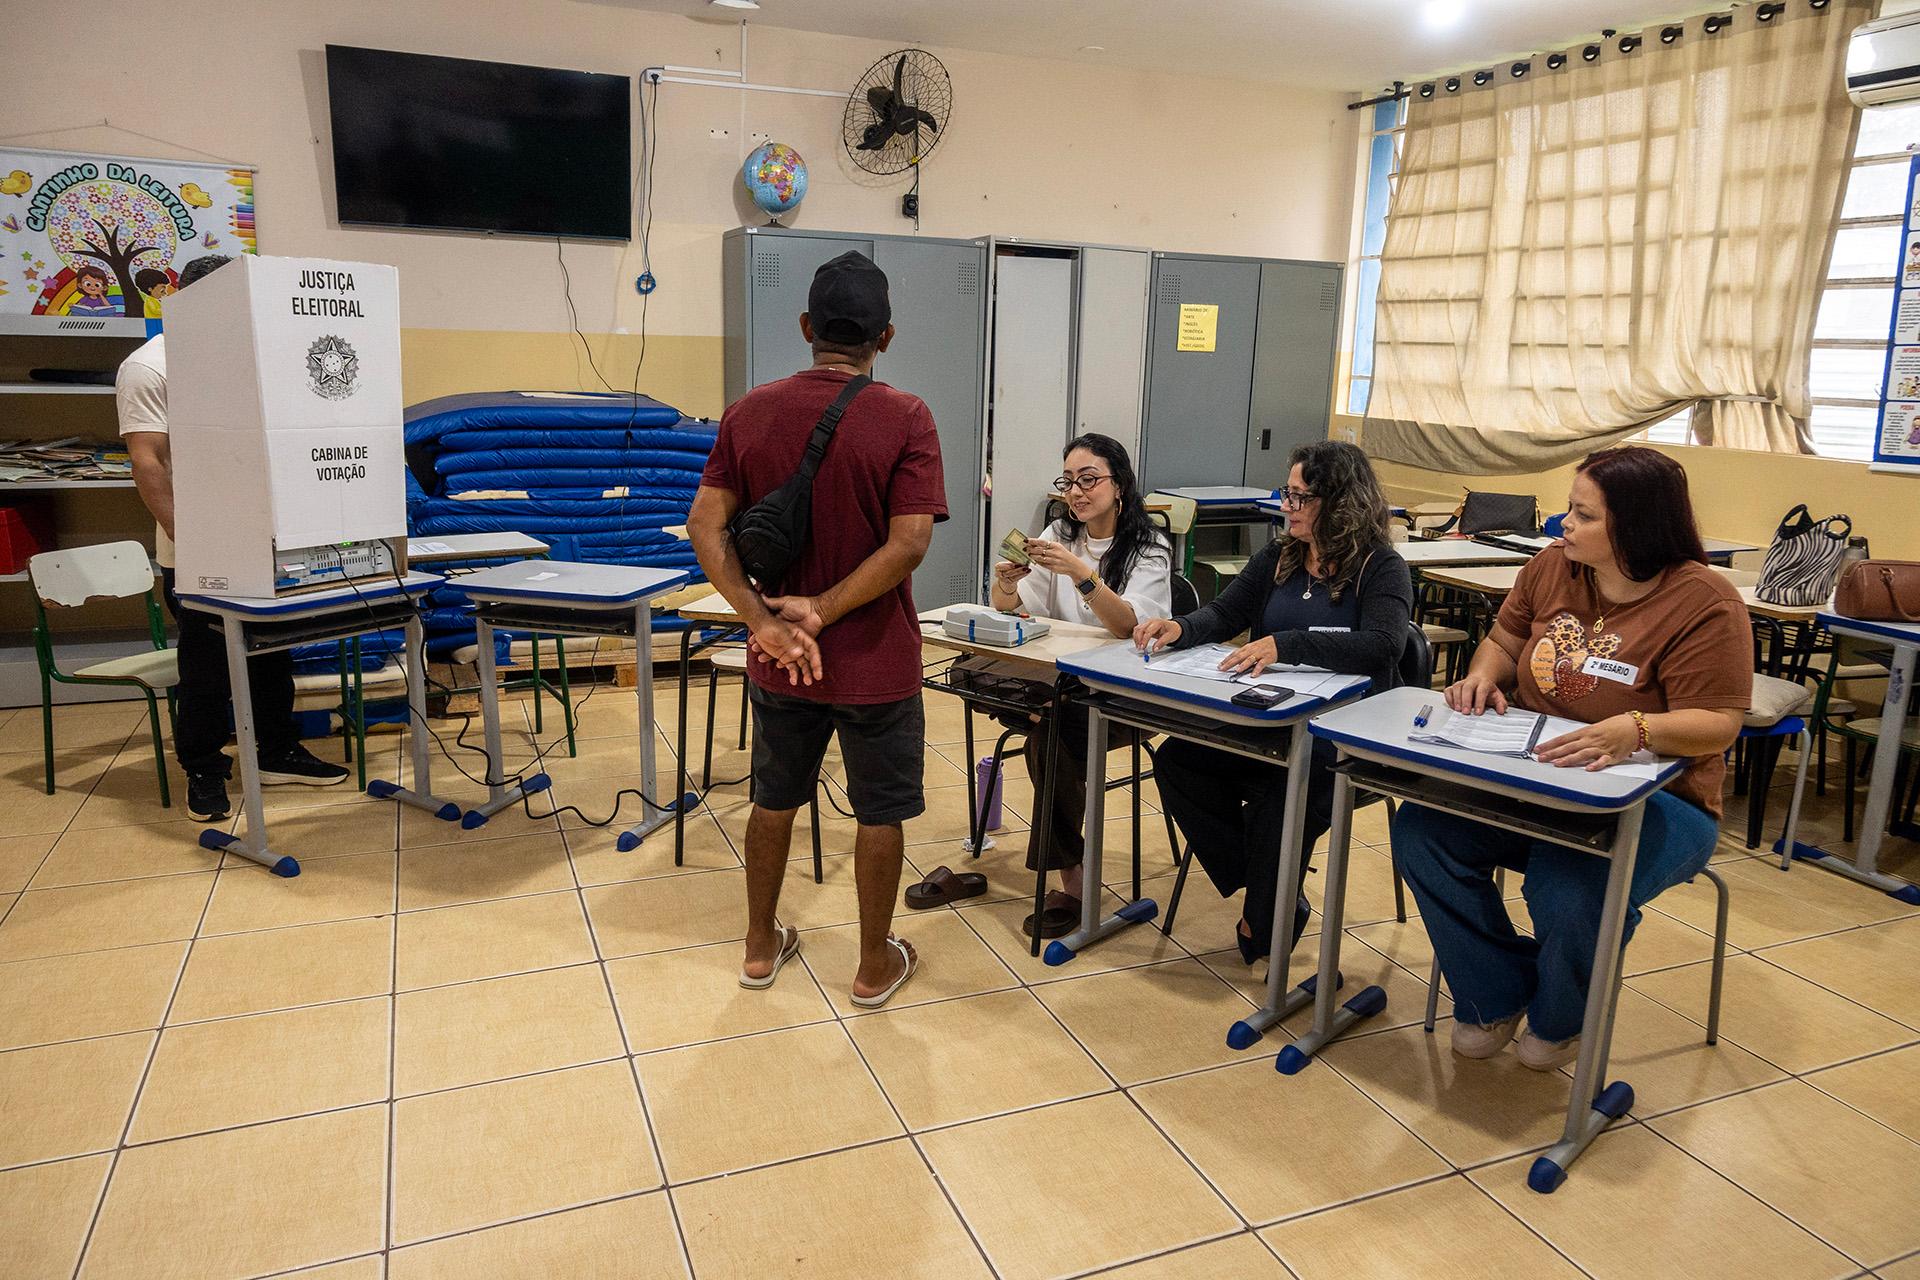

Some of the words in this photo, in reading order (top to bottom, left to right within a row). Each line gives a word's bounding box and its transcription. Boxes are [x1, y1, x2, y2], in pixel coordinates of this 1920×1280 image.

[26, 162, 99, 232] CANTINHO
[107, 163, 137, 184] DA
[138, 174, 198, 242] LEITURA
[299, 270, 355, 295] JUSTIÇA
[292, 297, 365, 318] ELEITORAL
[311, 447, 350, 462] CABINA
[354, 446, 368, 459] DE
[316, 464, 366, 483] VOTAÇÃO
